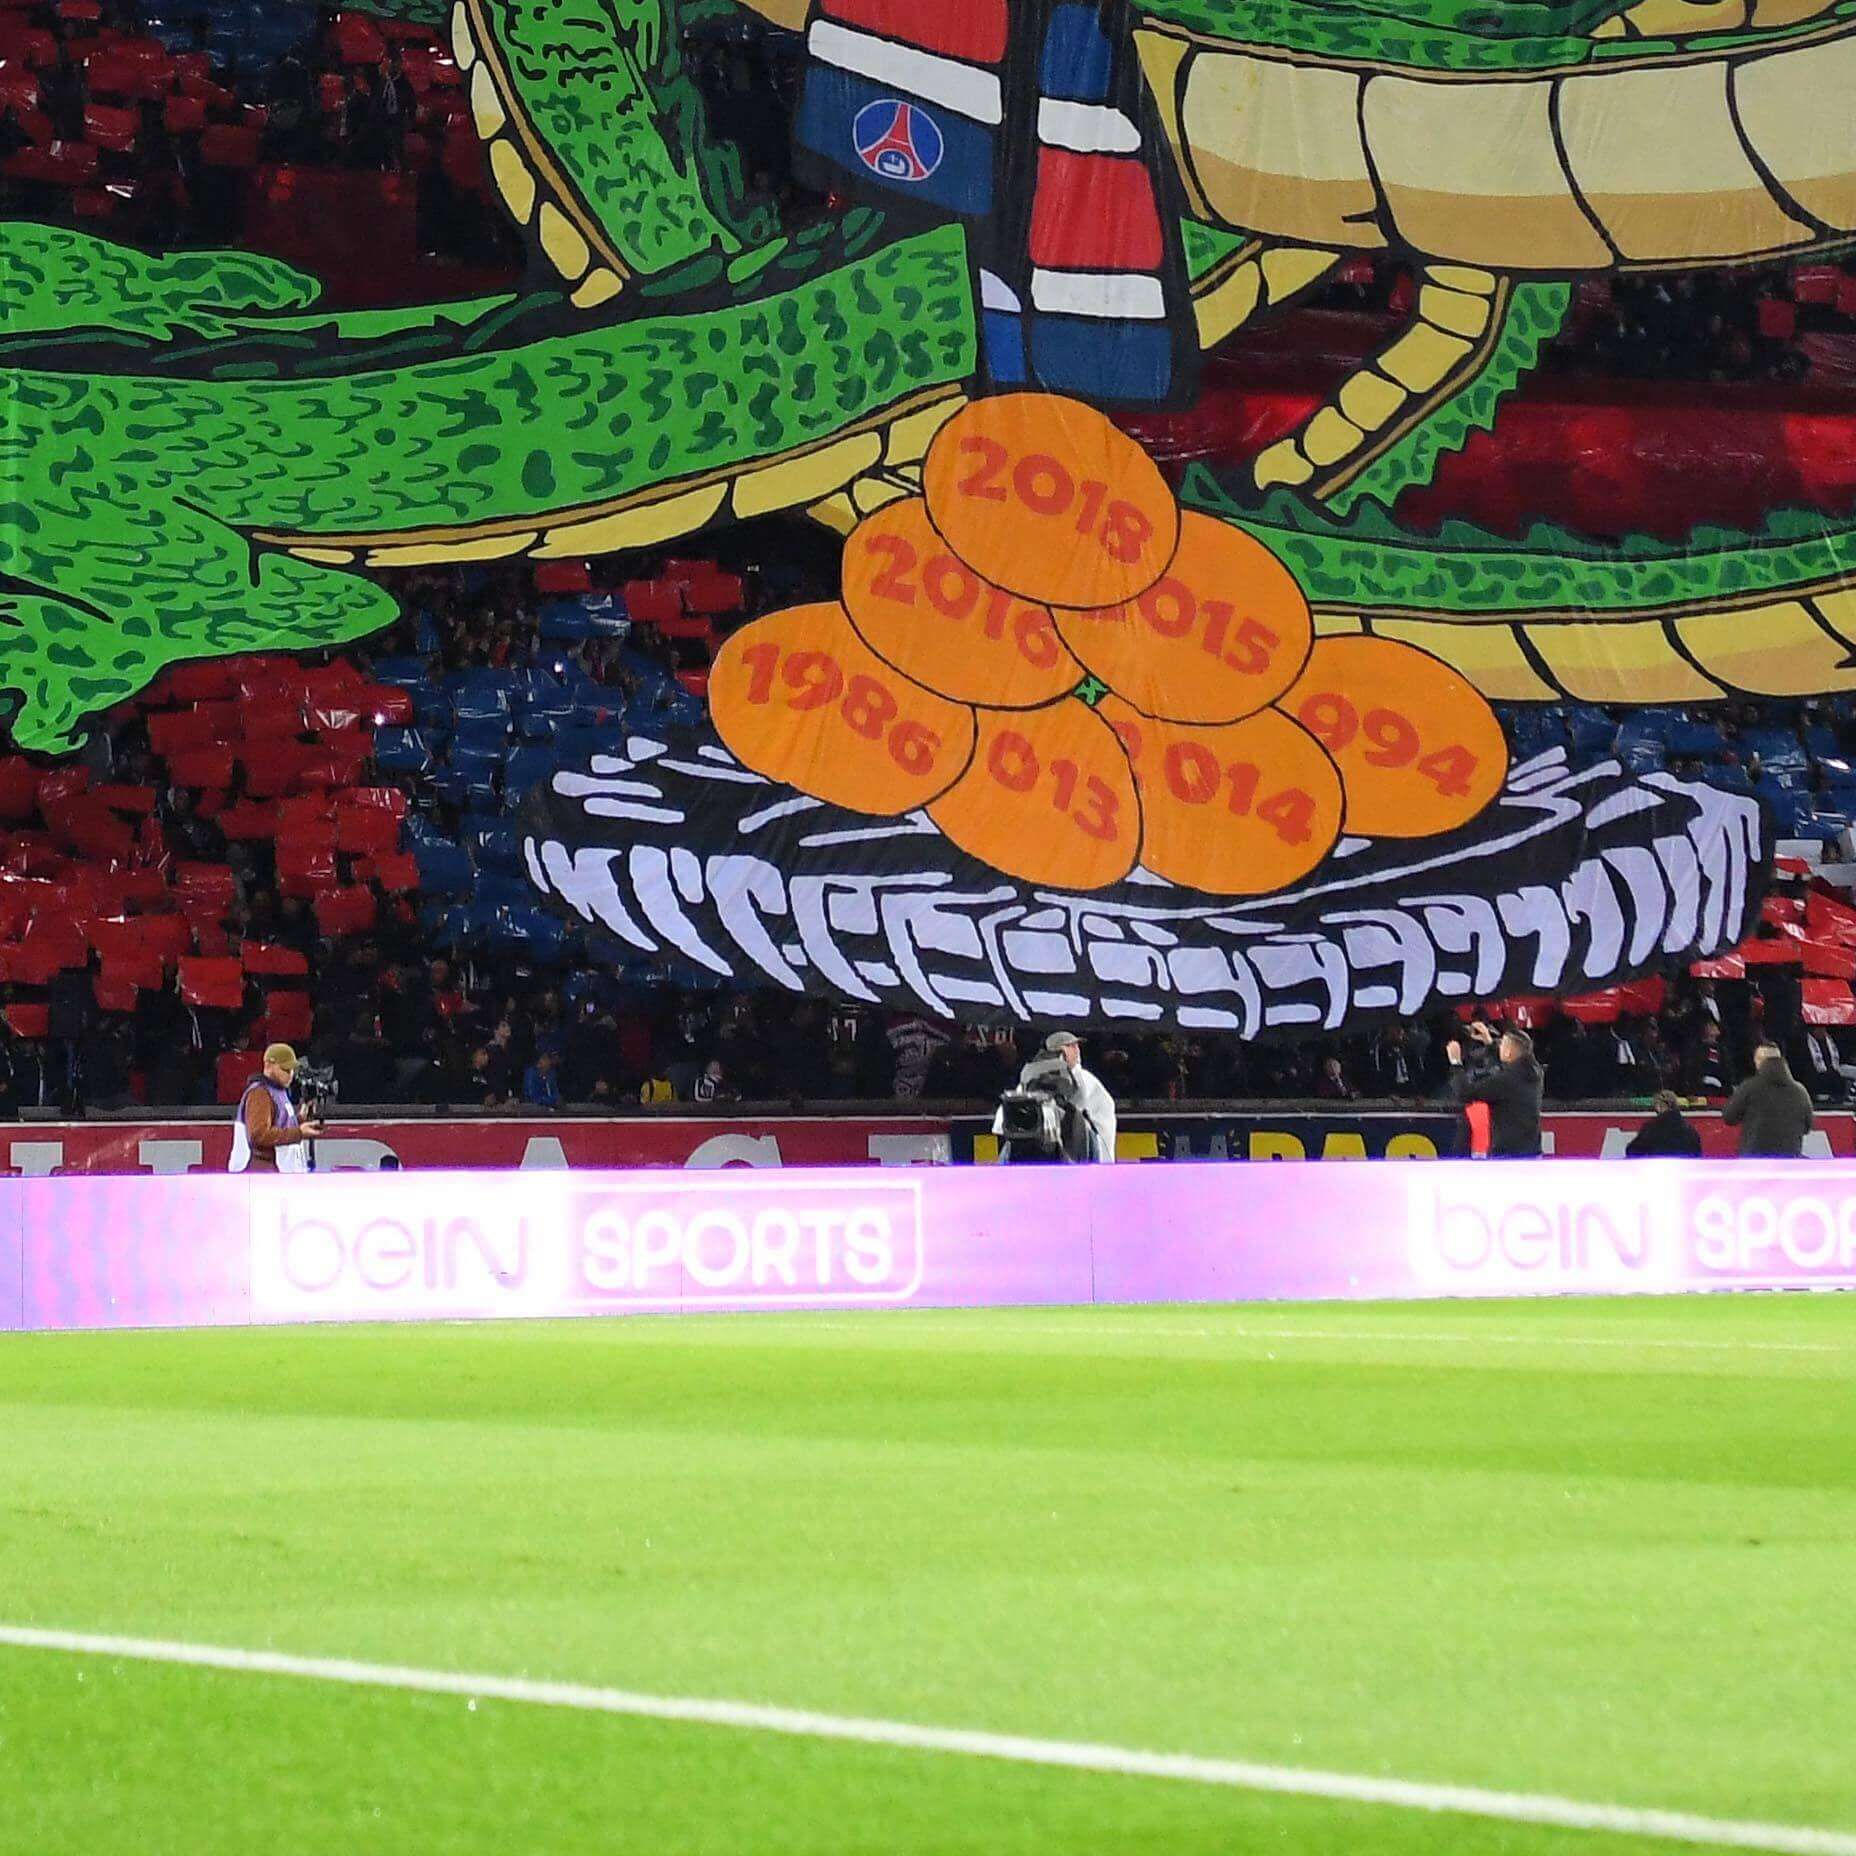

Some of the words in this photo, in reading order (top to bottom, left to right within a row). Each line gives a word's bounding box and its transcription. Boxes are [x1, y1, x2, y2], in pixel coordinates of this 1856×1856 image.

[957, 436, 1153, 564] 2018
[865, 533, 1058, 670] 2016
[1077, 576, 1281, 676] 015
[742, 642, 941, 776] 1986
[1297, 692, 1478, 798] 994
[987, 729, 1120, 842] 013
[585, 1212, 892, 1288] SPORTS
